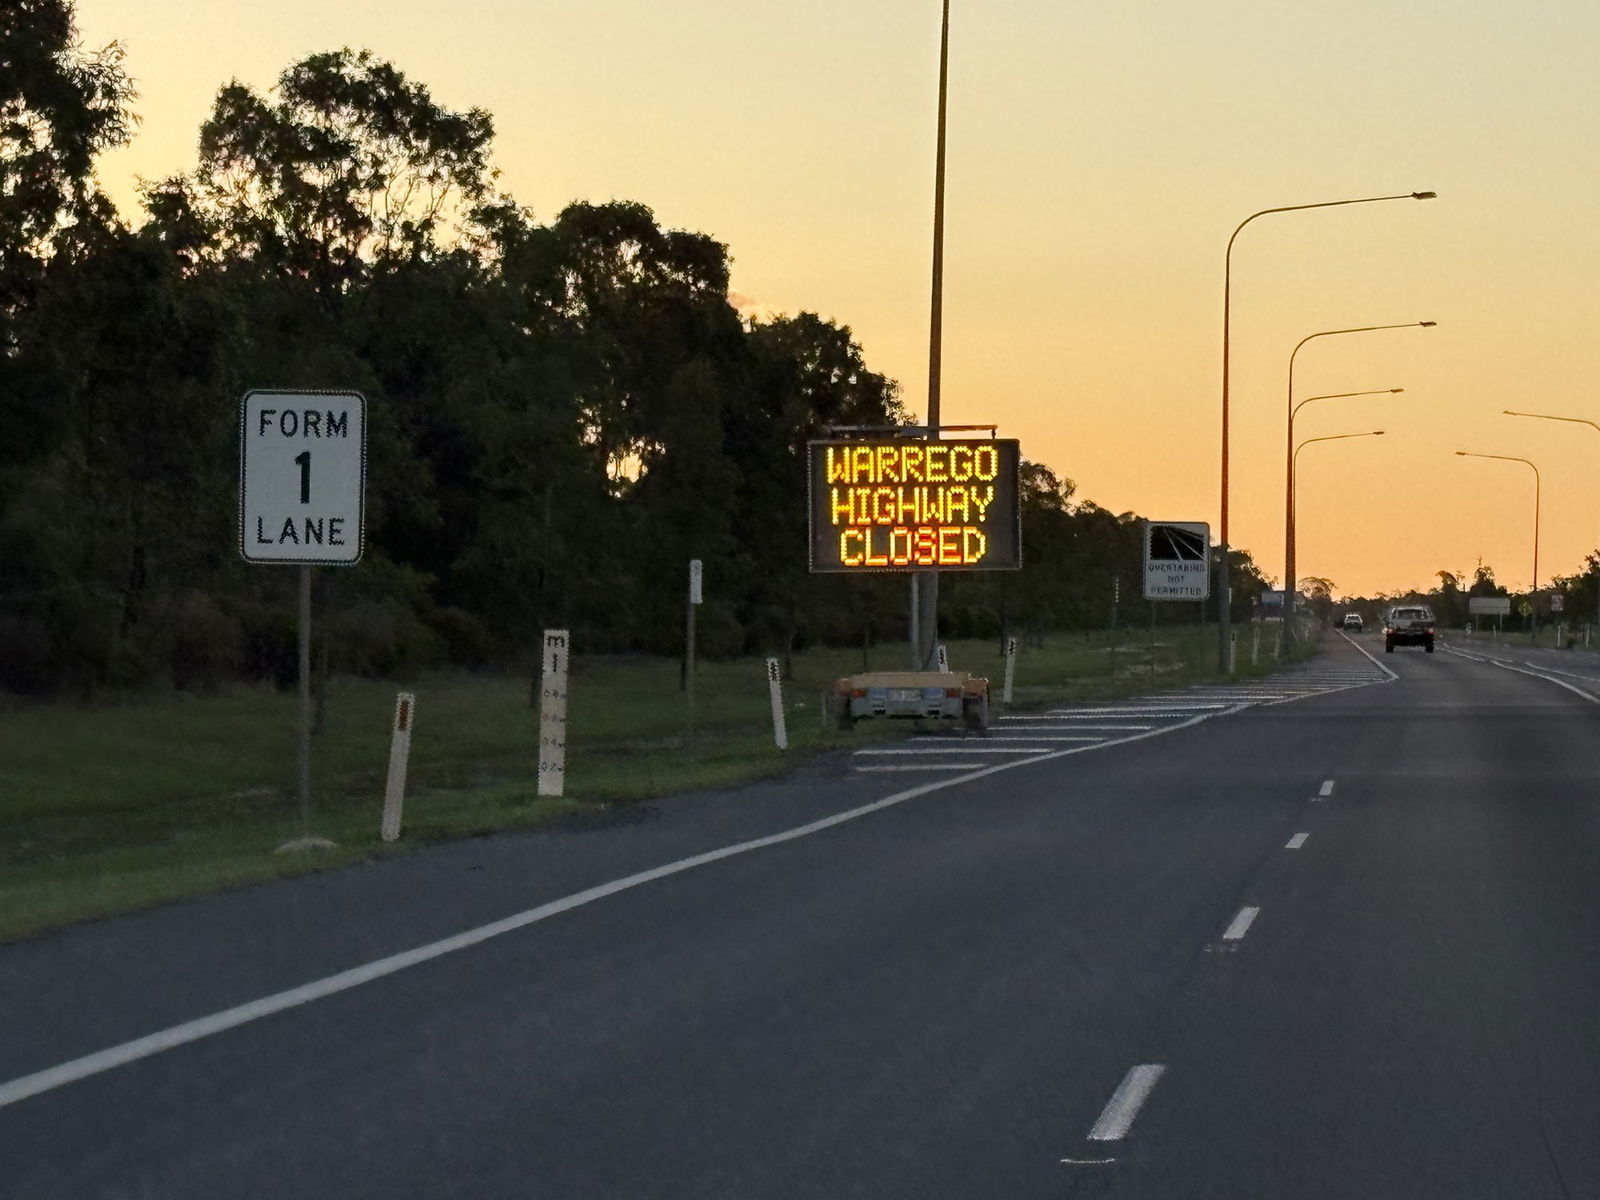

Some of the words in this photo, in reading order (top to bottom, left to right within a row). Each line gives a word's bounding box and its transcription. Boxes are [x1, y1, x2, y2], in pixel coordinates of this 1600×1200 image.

[258, 409, 348, 438] FORM
[294, 450, 312, 504] 1
[826, 445, 998, 484] WARREGO
[831, 485, 994, 525] HIGHWAY
[257, 516, 345, 546] LANE
[840, 526, 986, 567] CLOSED
[1167, 575, 1185, 584] NOT
